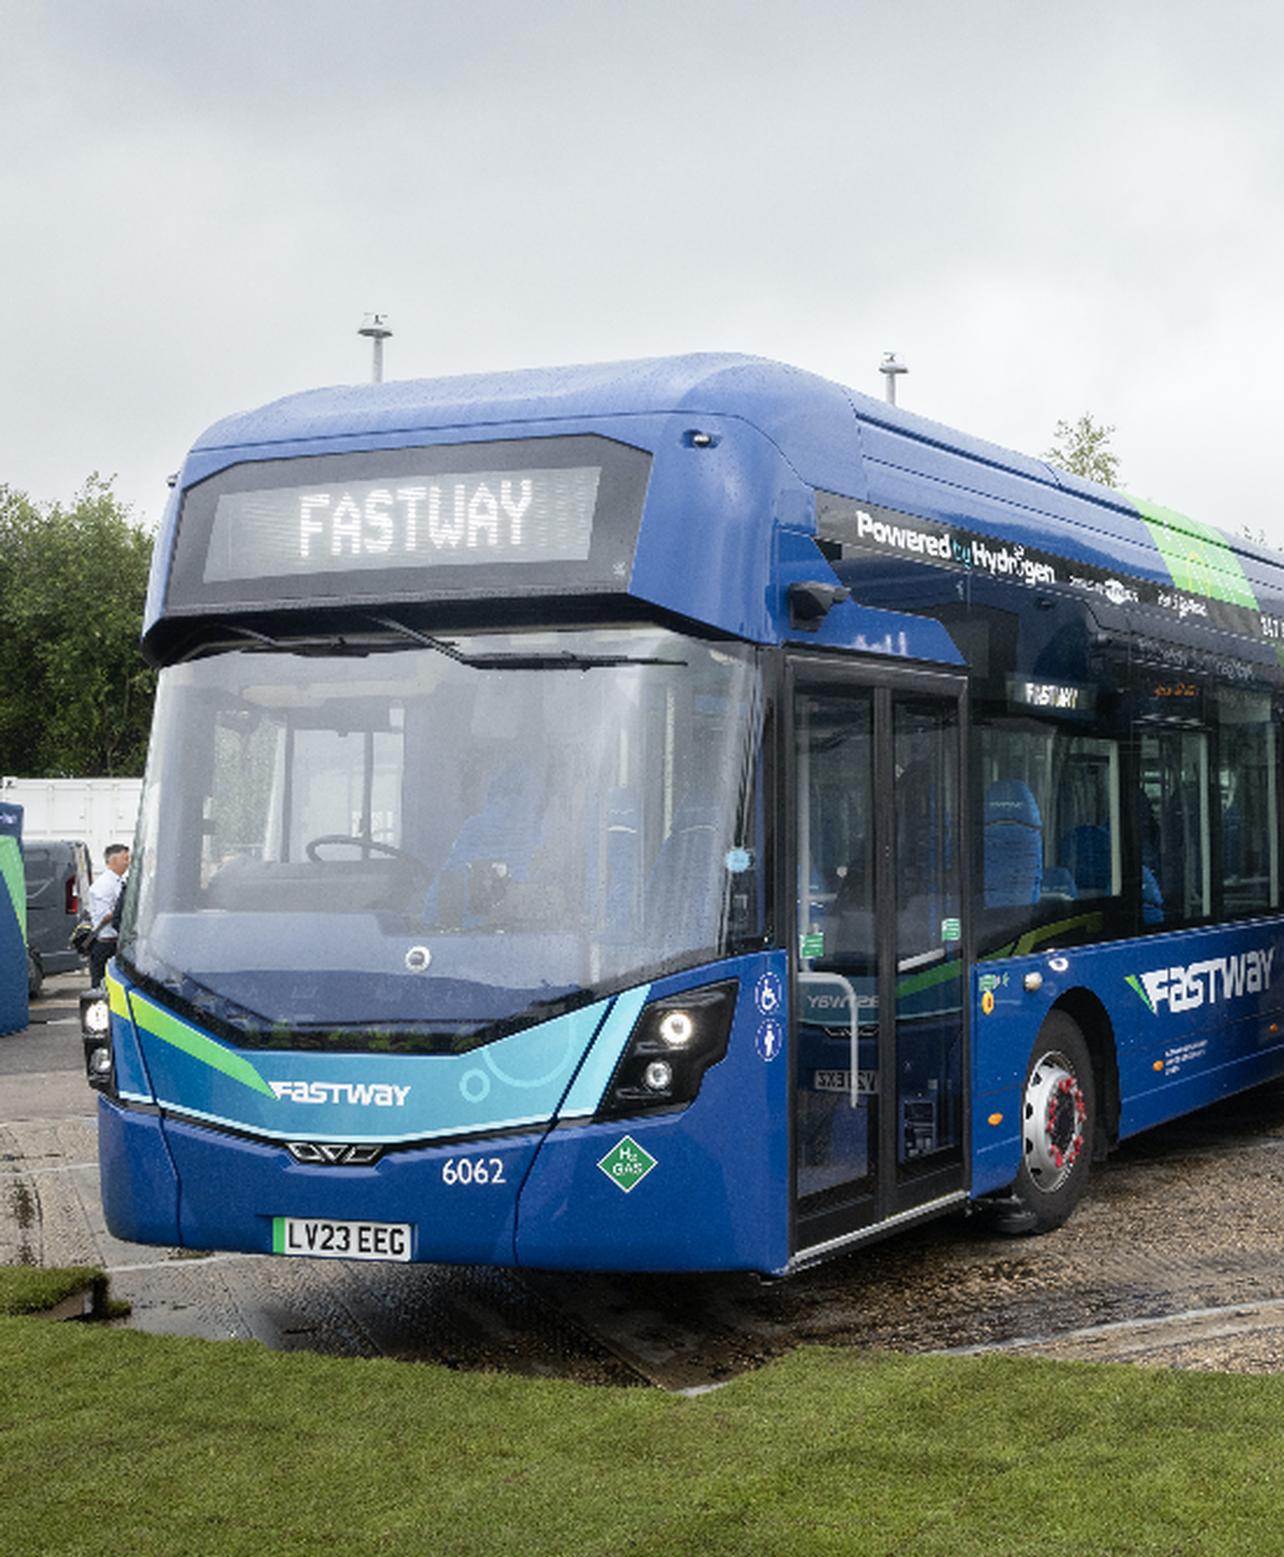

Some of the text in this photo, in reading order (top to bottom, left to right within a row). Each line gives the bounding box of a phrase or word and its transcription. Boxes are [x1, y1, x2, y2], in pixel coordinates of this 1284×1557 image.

[300, 480, 532, 557] FASTWAY
[856, 511, 951, 559] Powered
[442, 1158, 507, 1186] 6062
[612, 1163, 643, 1176] GAS
[288, 1223, 405, 1256] LV23 EEG
